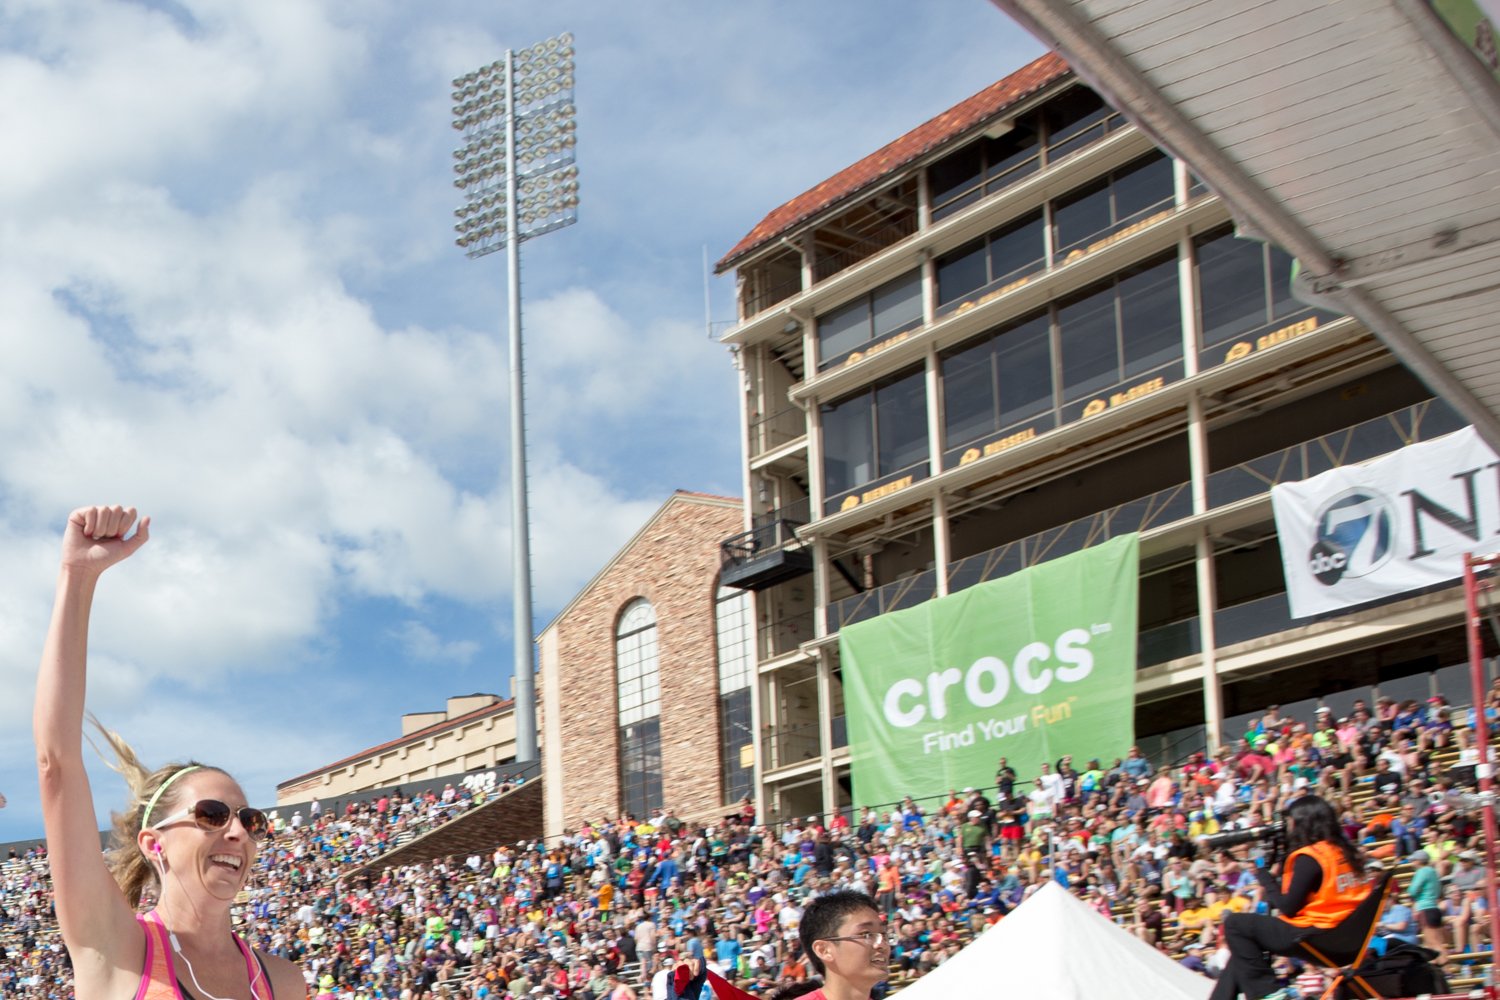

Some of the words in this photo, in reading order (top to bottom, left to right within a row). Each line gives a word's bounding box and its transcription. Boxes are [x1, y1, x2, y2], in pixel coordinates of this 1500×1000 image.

[983, 428, 1036, 457] RUSSELL
[1308, 552, 1347, 575] abc
[884, 628, 1094, 728] crocs
[922, 723, 975, 755] Find
[977, 714, 1028, 741] Your
[1032, 702, 1072, 728] Fun
